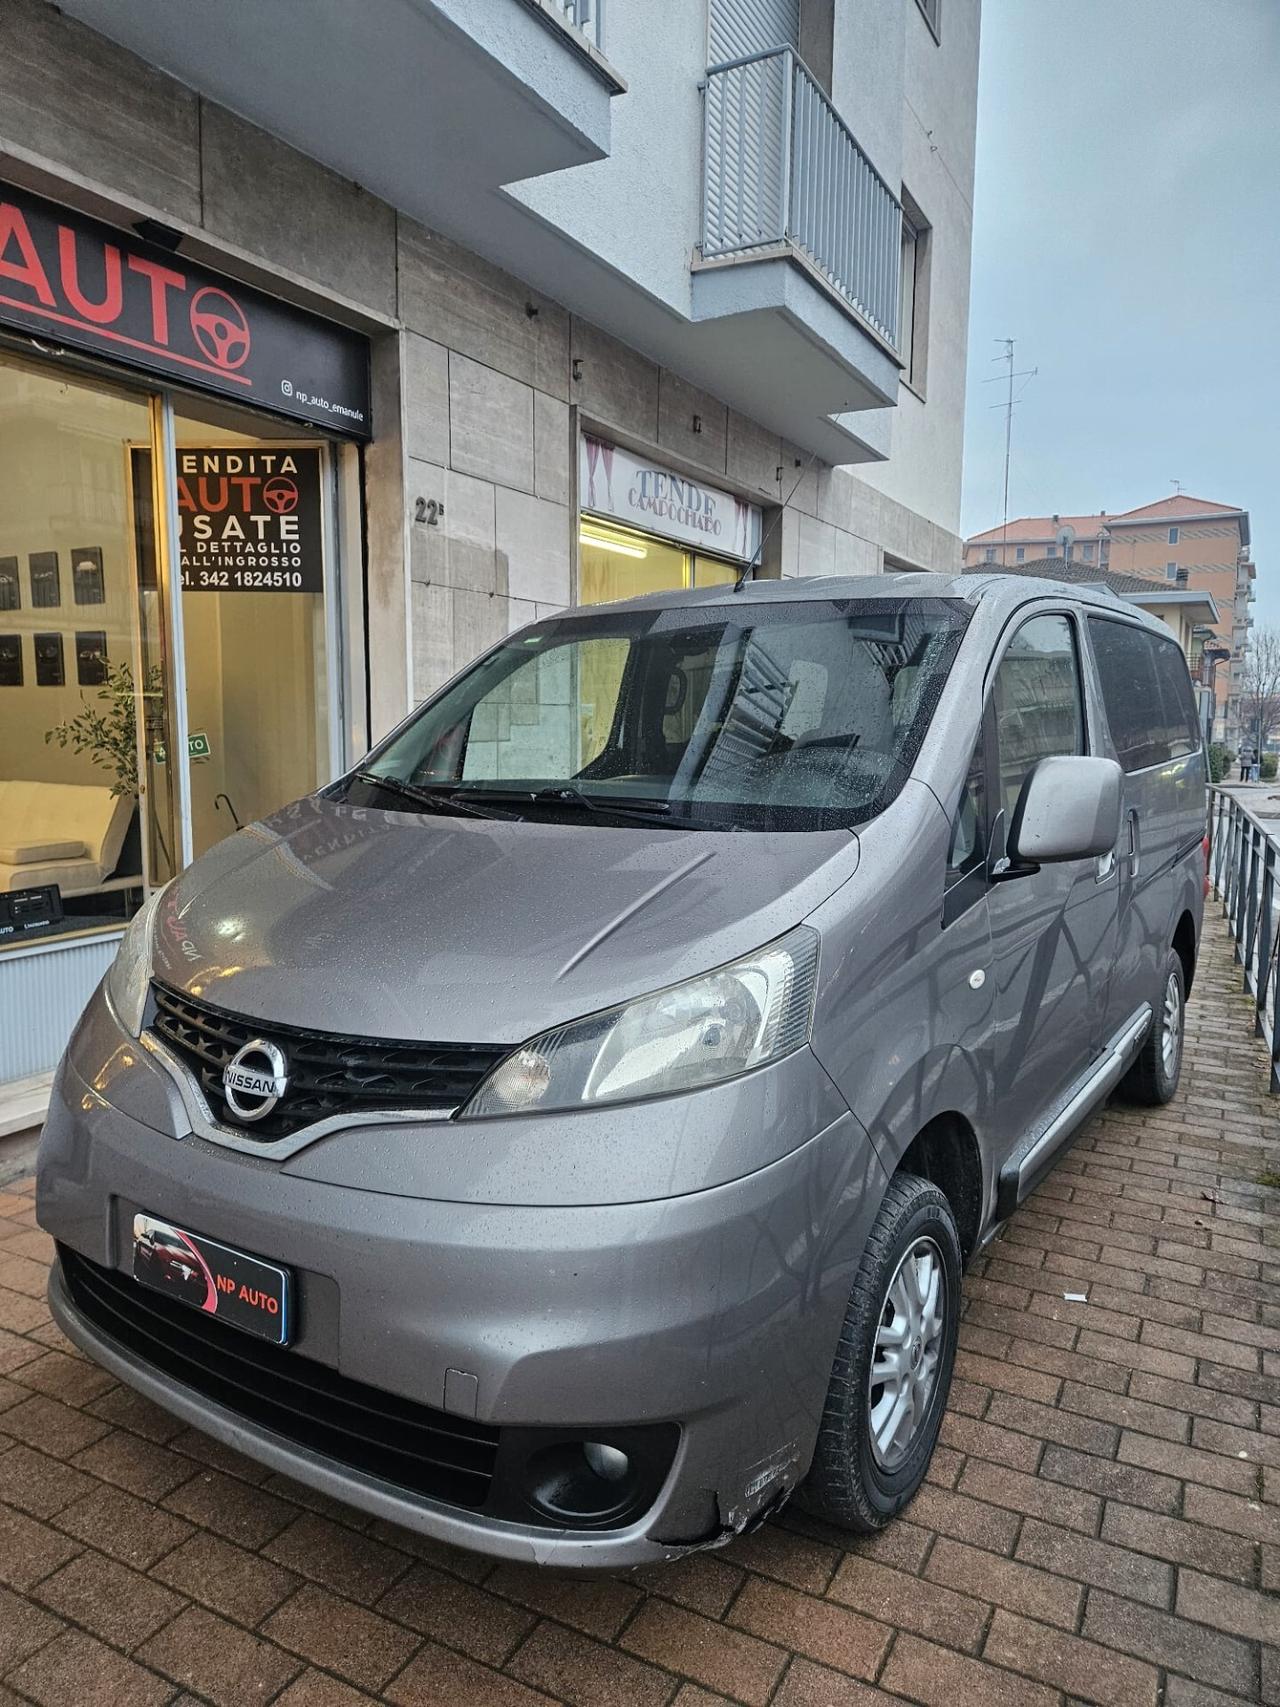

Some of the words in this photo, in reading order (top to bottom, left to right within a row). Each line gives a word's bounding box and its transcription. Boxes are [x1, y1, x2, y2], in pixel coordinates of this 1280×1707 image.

[182, 455, 298, 474] ENDITA
[635, 470, 717, 517] TENDE
[197, 542, 301, 554] DETTAGLIO
[181, 556, 301, 567] ALL'INGROSSO
[200, 571, 229, 586] 342
[234, 572, 302, 587] 1824510
[227, 1070, 275, 1093] NISSAN
[216, 1274, 236, 1294] NP
[238, 1285, 278, 1314] AUTO
